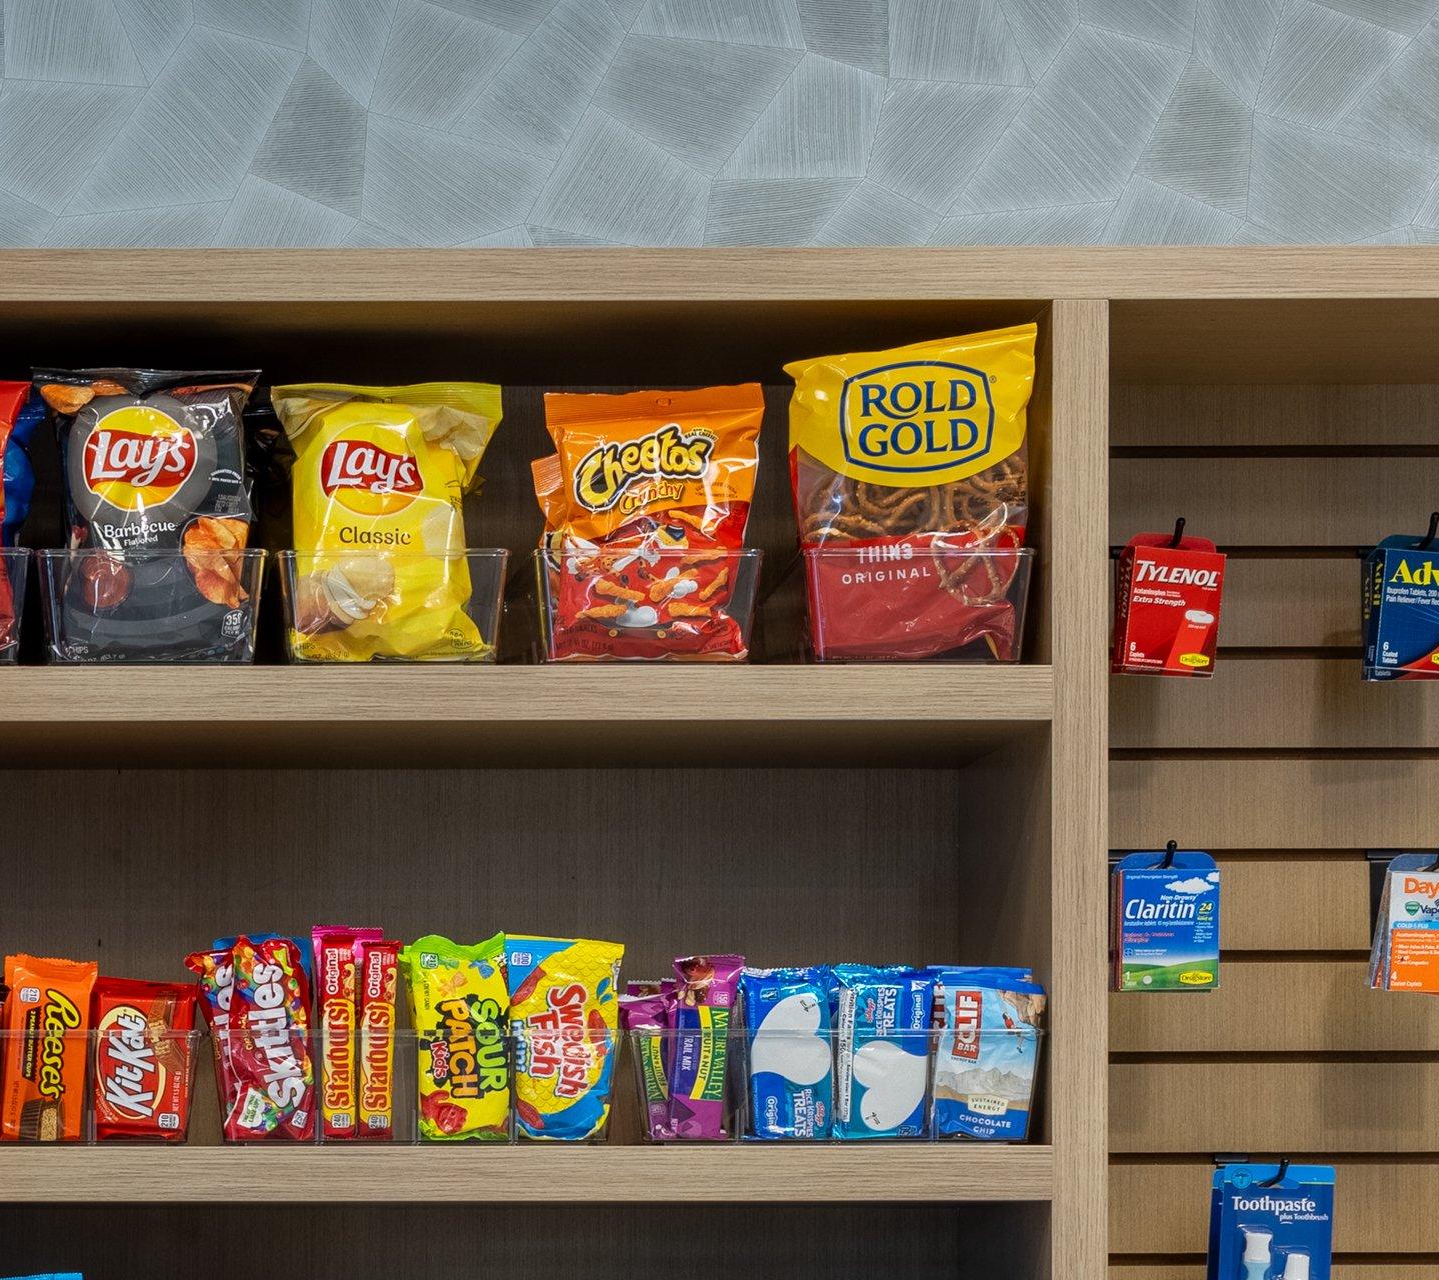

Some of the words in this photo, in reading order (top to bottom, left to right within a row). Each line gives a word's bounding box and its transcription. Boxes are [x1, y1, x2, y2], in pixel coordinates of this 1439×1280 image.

[860, 379, 977, 420] ROLD
[91, 431, 190, 484] Lay's
[858, 418, 978, 456] GOLD
[326, 442, 418, 494] Lay's
[576, 426, 713, 512] Cheetos
[104, 521, 176, 539] Barbecue
[339, 527, 412, 546] Classic
[842, 566, 931, 584] ORIGINAL
[1136, 560, 1219, 587] TYLENOL
[1133, 596, 1153, 604] Extra
[1154, 597, 1186, 608] Strength
[1125, 899, 1194, 920] Claritin
[325, 948, 338, 995] Original
[367, 952, 381, 998] Original
[253, 963, 306, 1108] Skittles
[546, 983, 589, 1098] Swedish
[959, 995, 979, 1041] CLIF
[38, 989, 81, 1101] Reese's
[324, 998, 351, 1110] Starburst
[360, 1002, 390, 1112] Starburst
[431, 1042, 448, 1079] Kids
[440, 998, 480, 1099] PATCH
[472, 1000, 508, 1092] SOUR
[530, 1013, 562, 1078] Fish
[957, 1042, 976, 1053] BAR
[794, 1091, 807, 1138] TREATS
[959, 1114, 1011, 1128] CHOCOLATE
[973, 1125, 995, 1136] CHIP
[1232, 1196, 1316, 1217] Toothpaste
